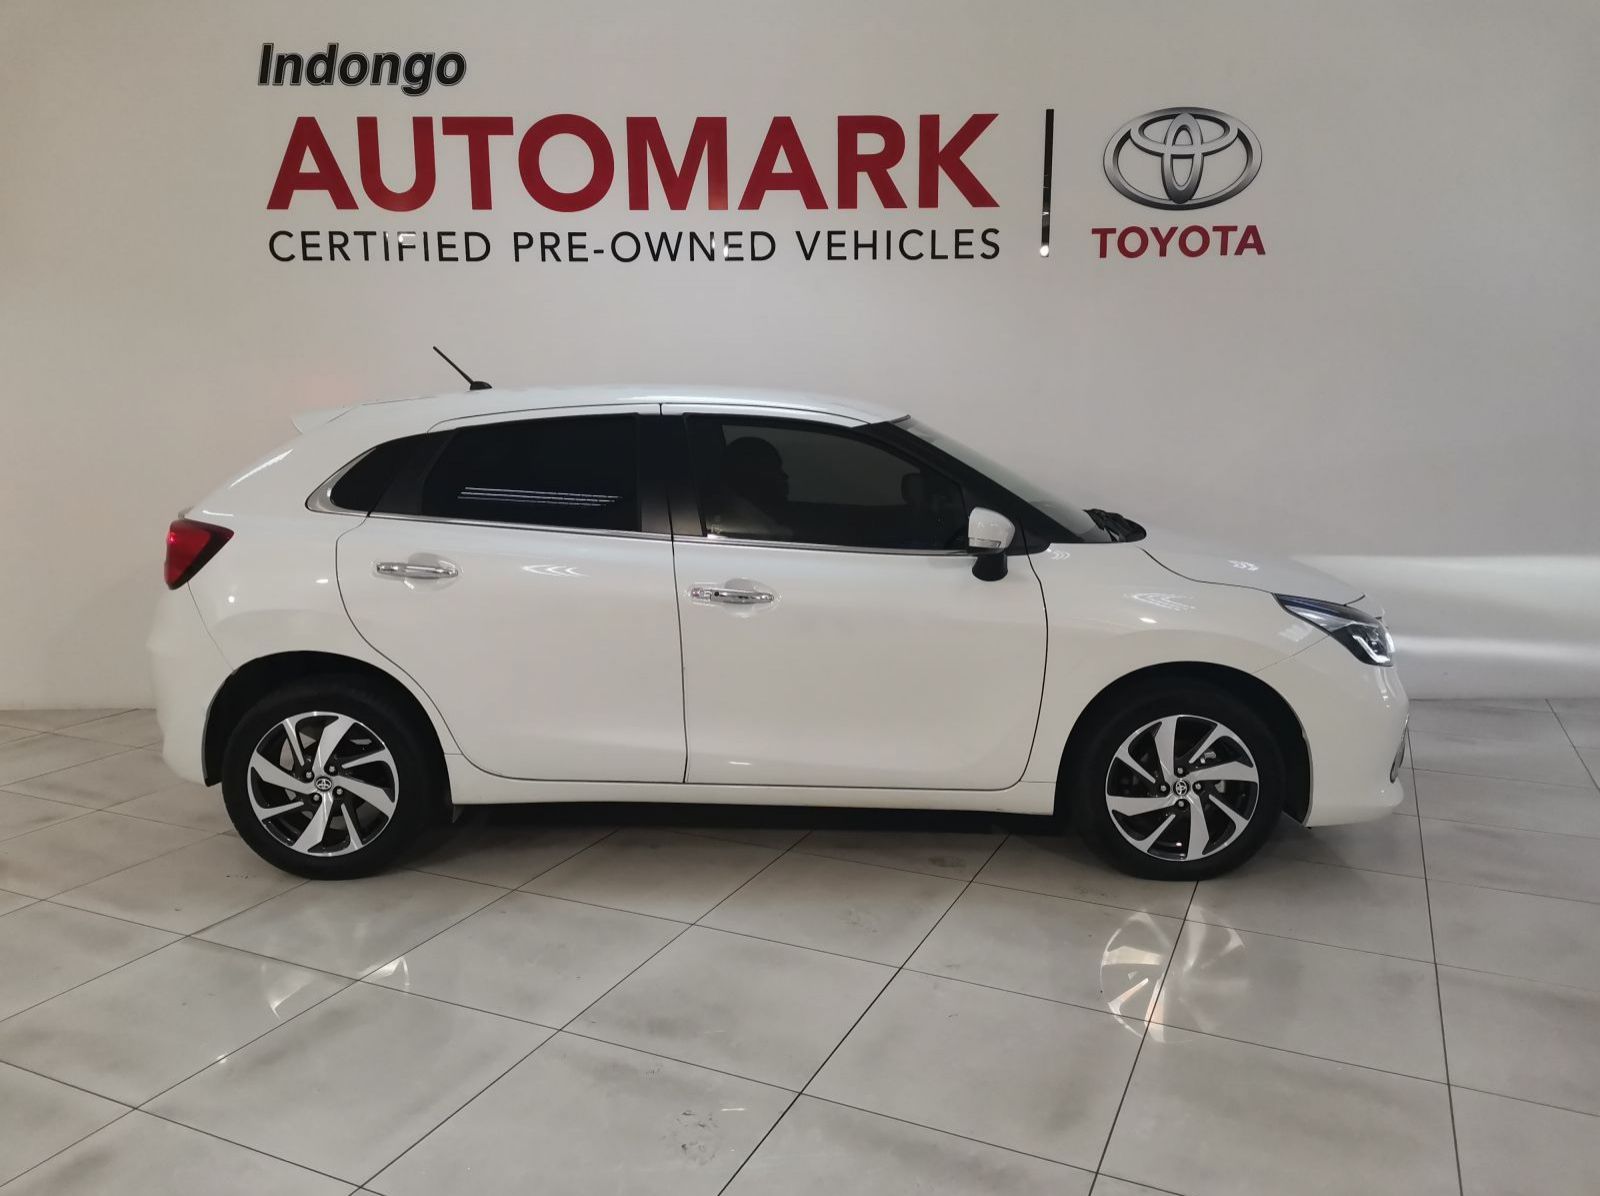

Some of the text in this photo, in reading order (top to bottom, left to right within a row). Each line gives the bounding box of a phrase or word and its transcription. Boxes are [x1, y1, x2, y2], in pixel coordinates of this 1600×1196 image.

[257, 42, 467, 97] Indongo
[266, 112, 1000, 212] AUTOMARK
[268, 227, 1001, 262] CERTIFIED PRE-OWNED VEHICLES
[1091, 224, 1267, 259] TOYOTA
